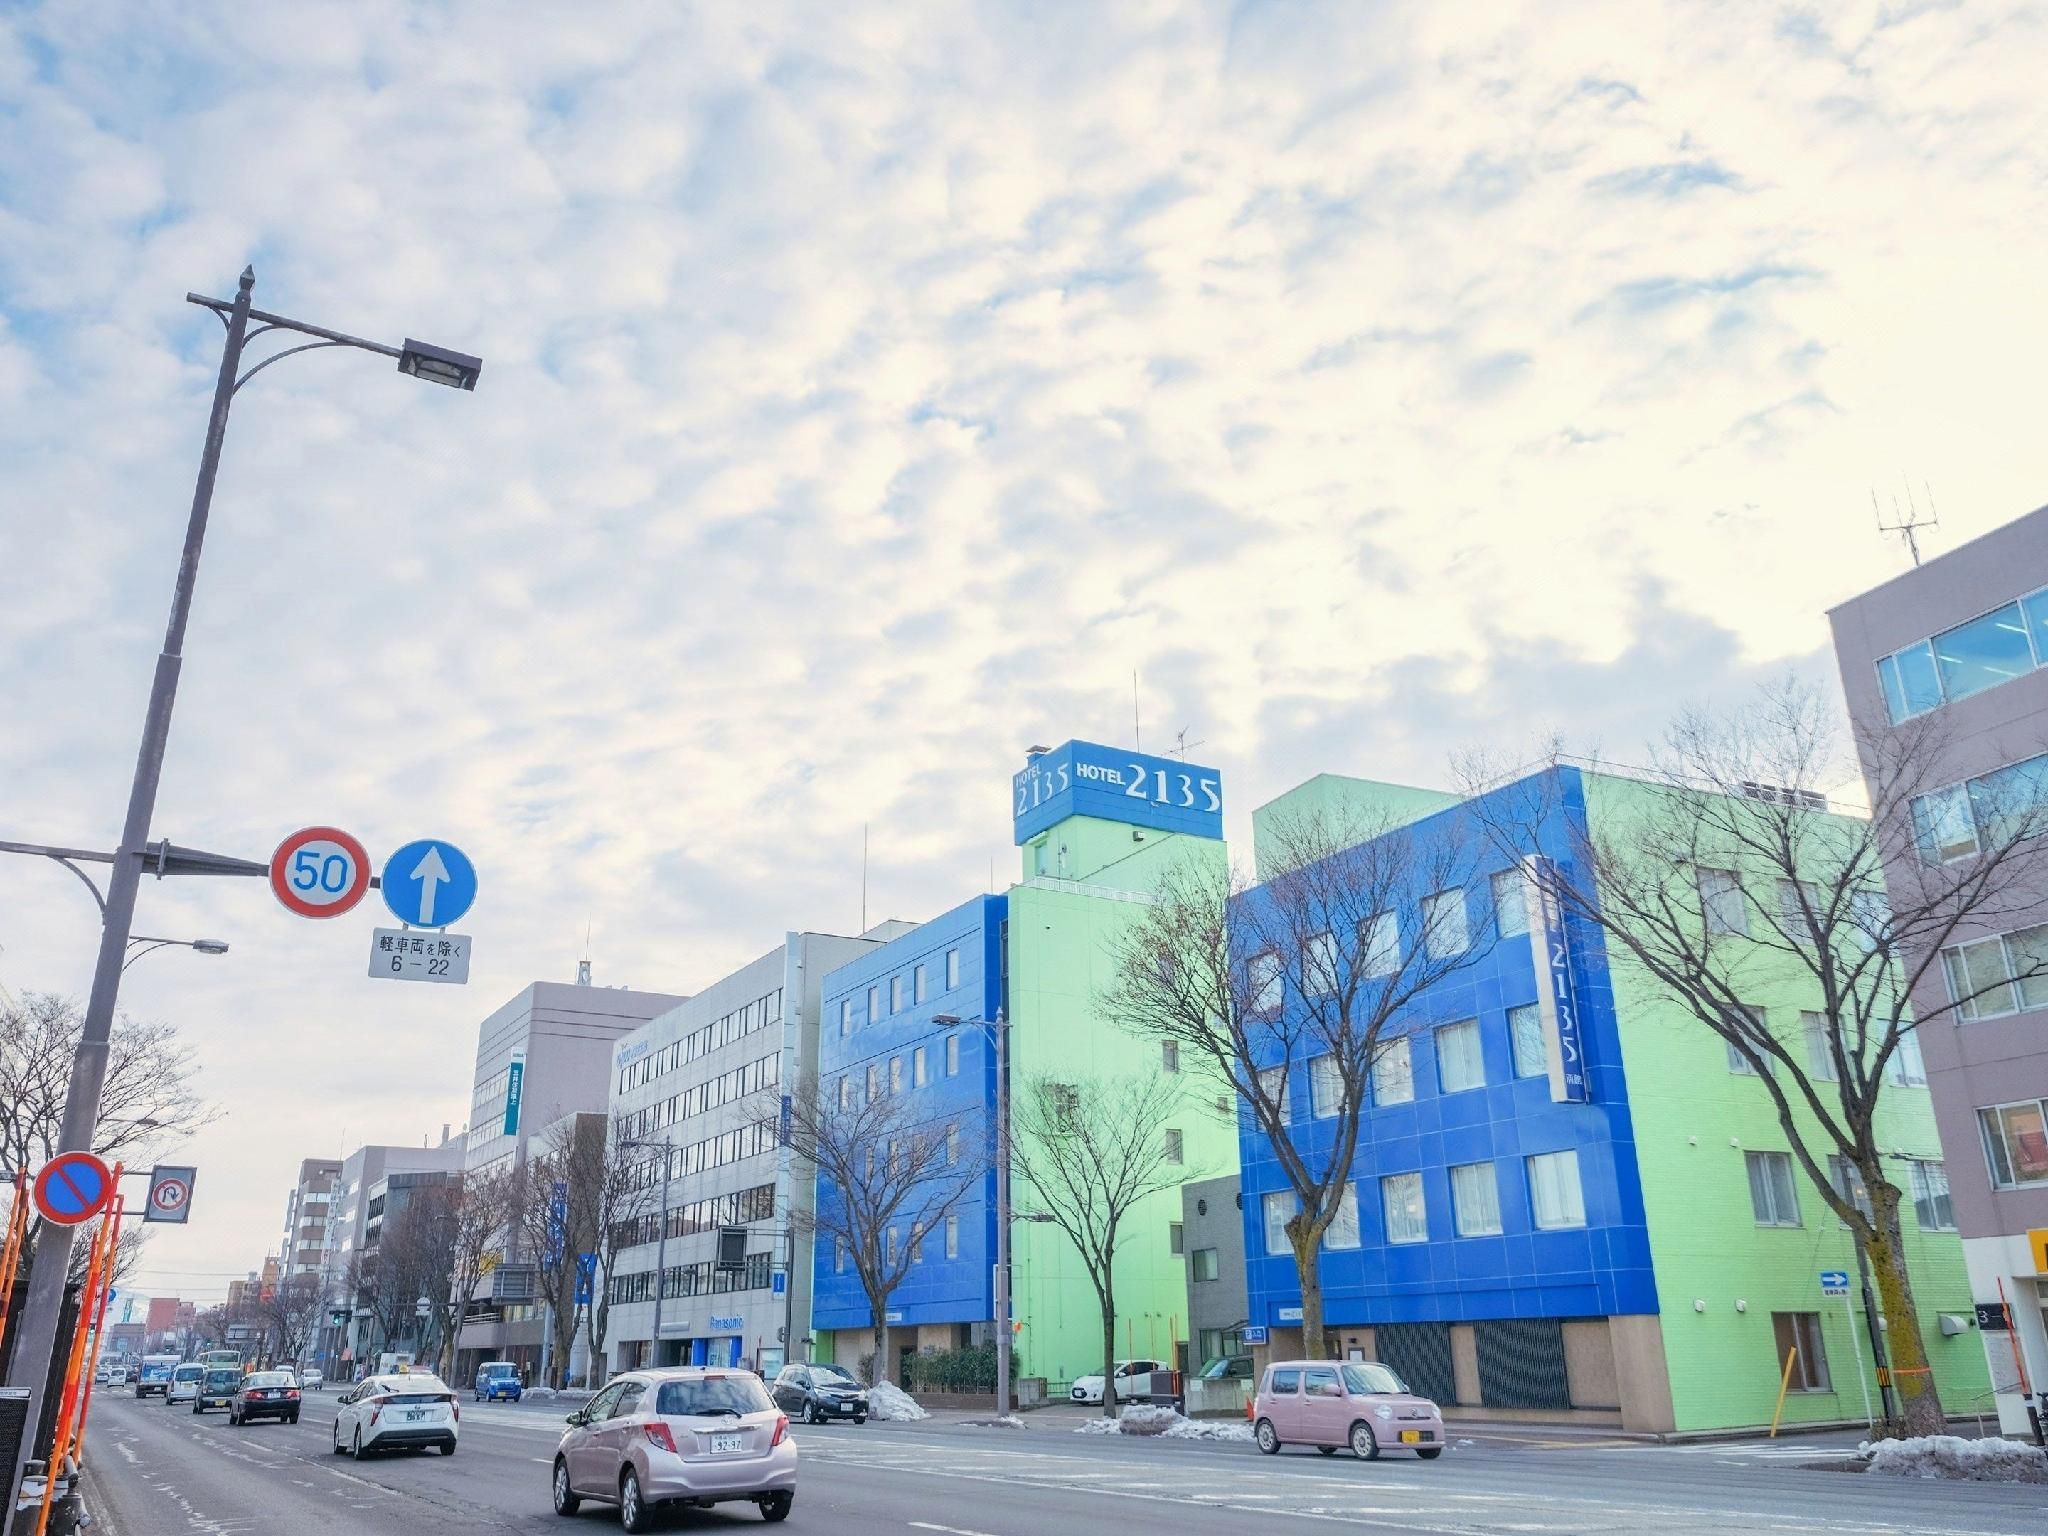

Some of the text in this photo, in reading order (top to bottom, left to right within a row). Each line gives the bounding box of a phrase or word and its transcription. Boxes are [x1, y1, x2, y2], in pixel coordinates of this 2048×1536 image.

[1016, 763, 1041, 788] HOTEL
[1016, 763, 1069, 817] 2135
[1076, 763, 1220, 812] HOTEL 2135
[293, 851, 348, 893] 50
[379, 935, 461, 958] 軽車両を除く
[391, 955, 402, 972] 6
[427, 959, 449, 976] 22
[1551, 943, 1578, 1062] 2135
[710, 1314, 743, 1329] Panasonic
